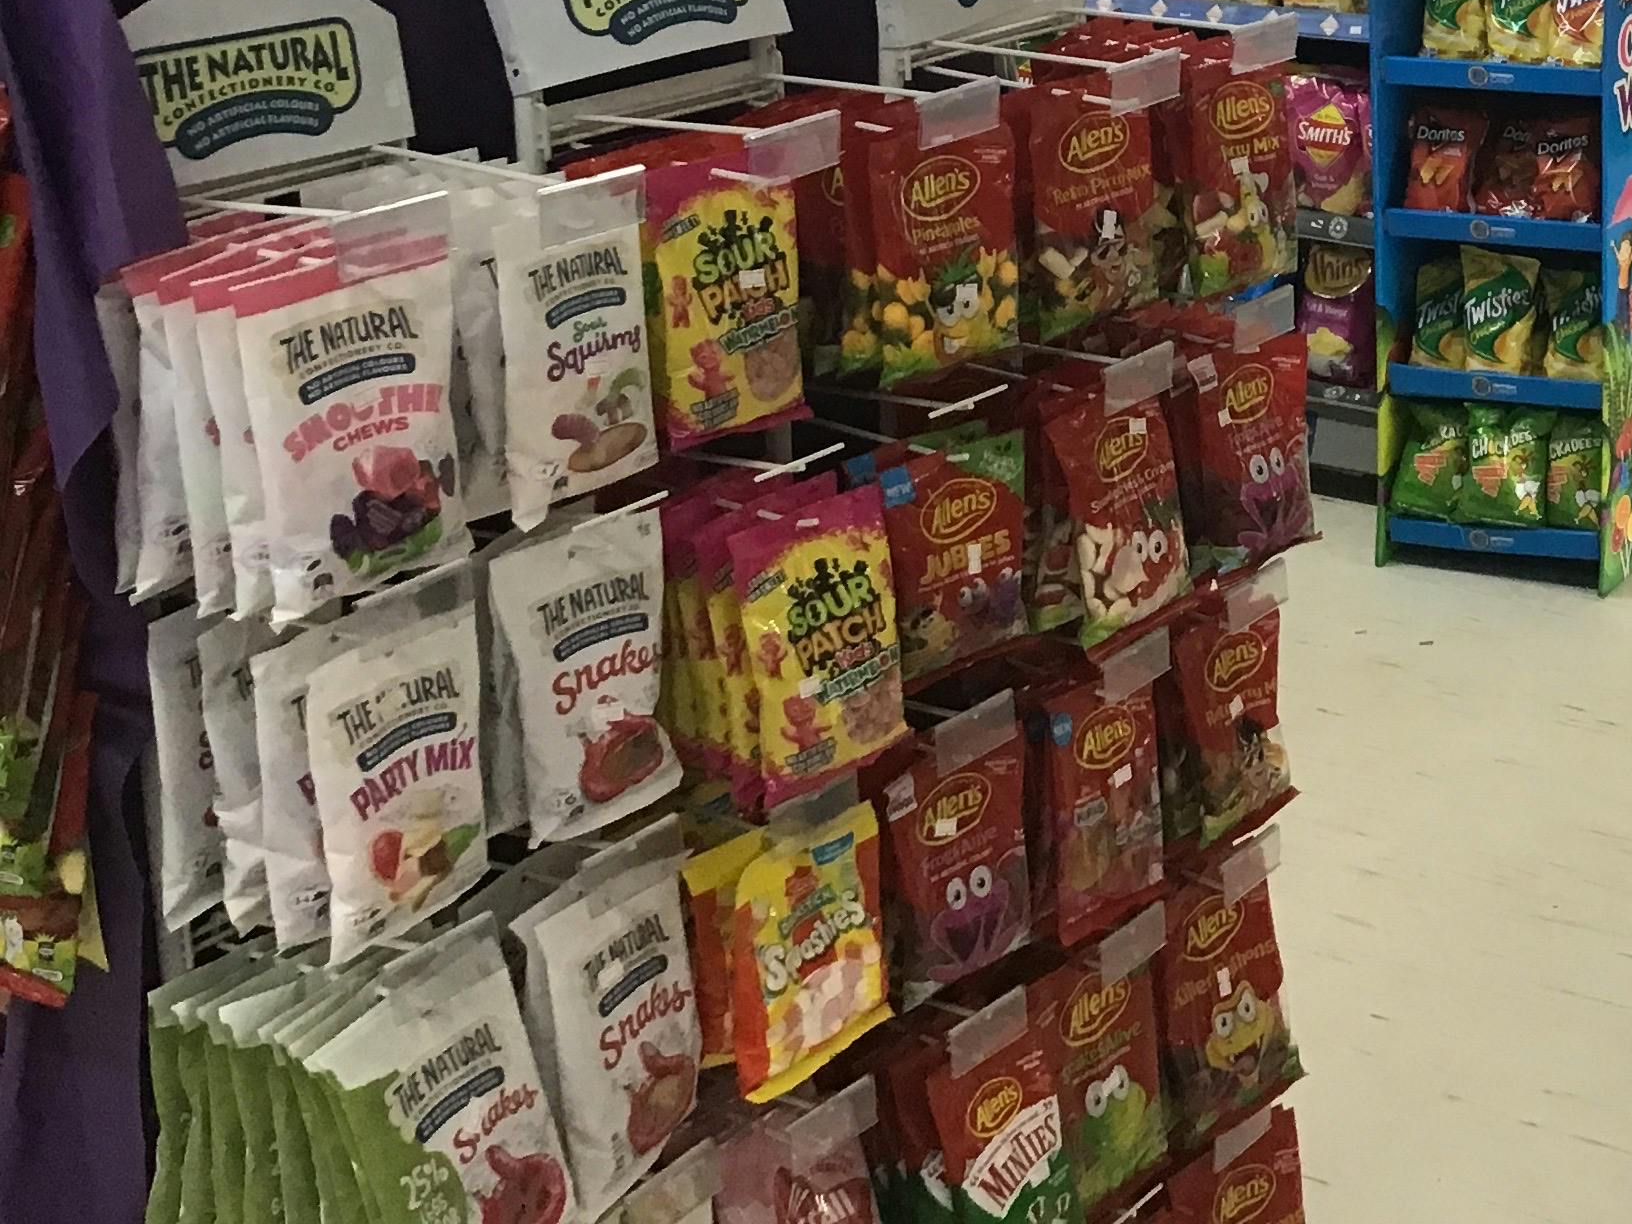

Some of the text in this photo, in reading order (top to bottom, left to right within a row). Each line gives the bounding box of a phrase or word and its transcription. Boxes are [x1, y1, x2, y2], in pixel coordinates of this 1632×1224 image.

[621, 11, 637, 25] NO
[627, 4, 728, 38] NO ARTIFICIAL FLAVOURS
[139, 30, 350, 115] THE NATURAL
[163, 75, 307, 126] CONFECTIONERY
[187, 98, 320, 137] NO ARTIFICIAL COLOURS
[1215, 92, 1271, 130] Allen's
[194, 114, 320, 151] NO ARTIFICIAL FLAVOURS
[1298, 120, 1354, 146] SMITH'S
[1417, 125, 1465, 143] Doritos
[1537, 134, 1590, 156] Doritos
[911, 167, 971, 210] Allen's
[528, 246, 628, 302] THE NATURAL
[693, 229, 778, 284] SOUR
[1464, 287, 1531, 331] Twisties
[280, 305, 419, 374] THE NATURAL
[333, 416, 409, 452] CHEWS
[932, 488, 991, 536] Allen's
[537, 572, 650, 635] THE NATURAL
[786, 575, 875, 637] SOUR
[792, 601, 886, 676] PATCH
[336, 699, 376, 745] THE
[1082, 715, 1132, 760] Allen's
[350, 748, 419, 821] PARTY
[923, 784, 983, 833] Allen's
[1188, 905, 1238, 953] Allen's
[1070, 980, 1126, 1038] Allen's
[393, 1023, 502, 1118] THE NATURAL
[453, 1083, 539, 1164] Sakes
[974, 1082, 1021, 1131] Allen's
[400, 1158, 450, 1211] 25%
[977, 1112, 1059, 1209] MINTIES
